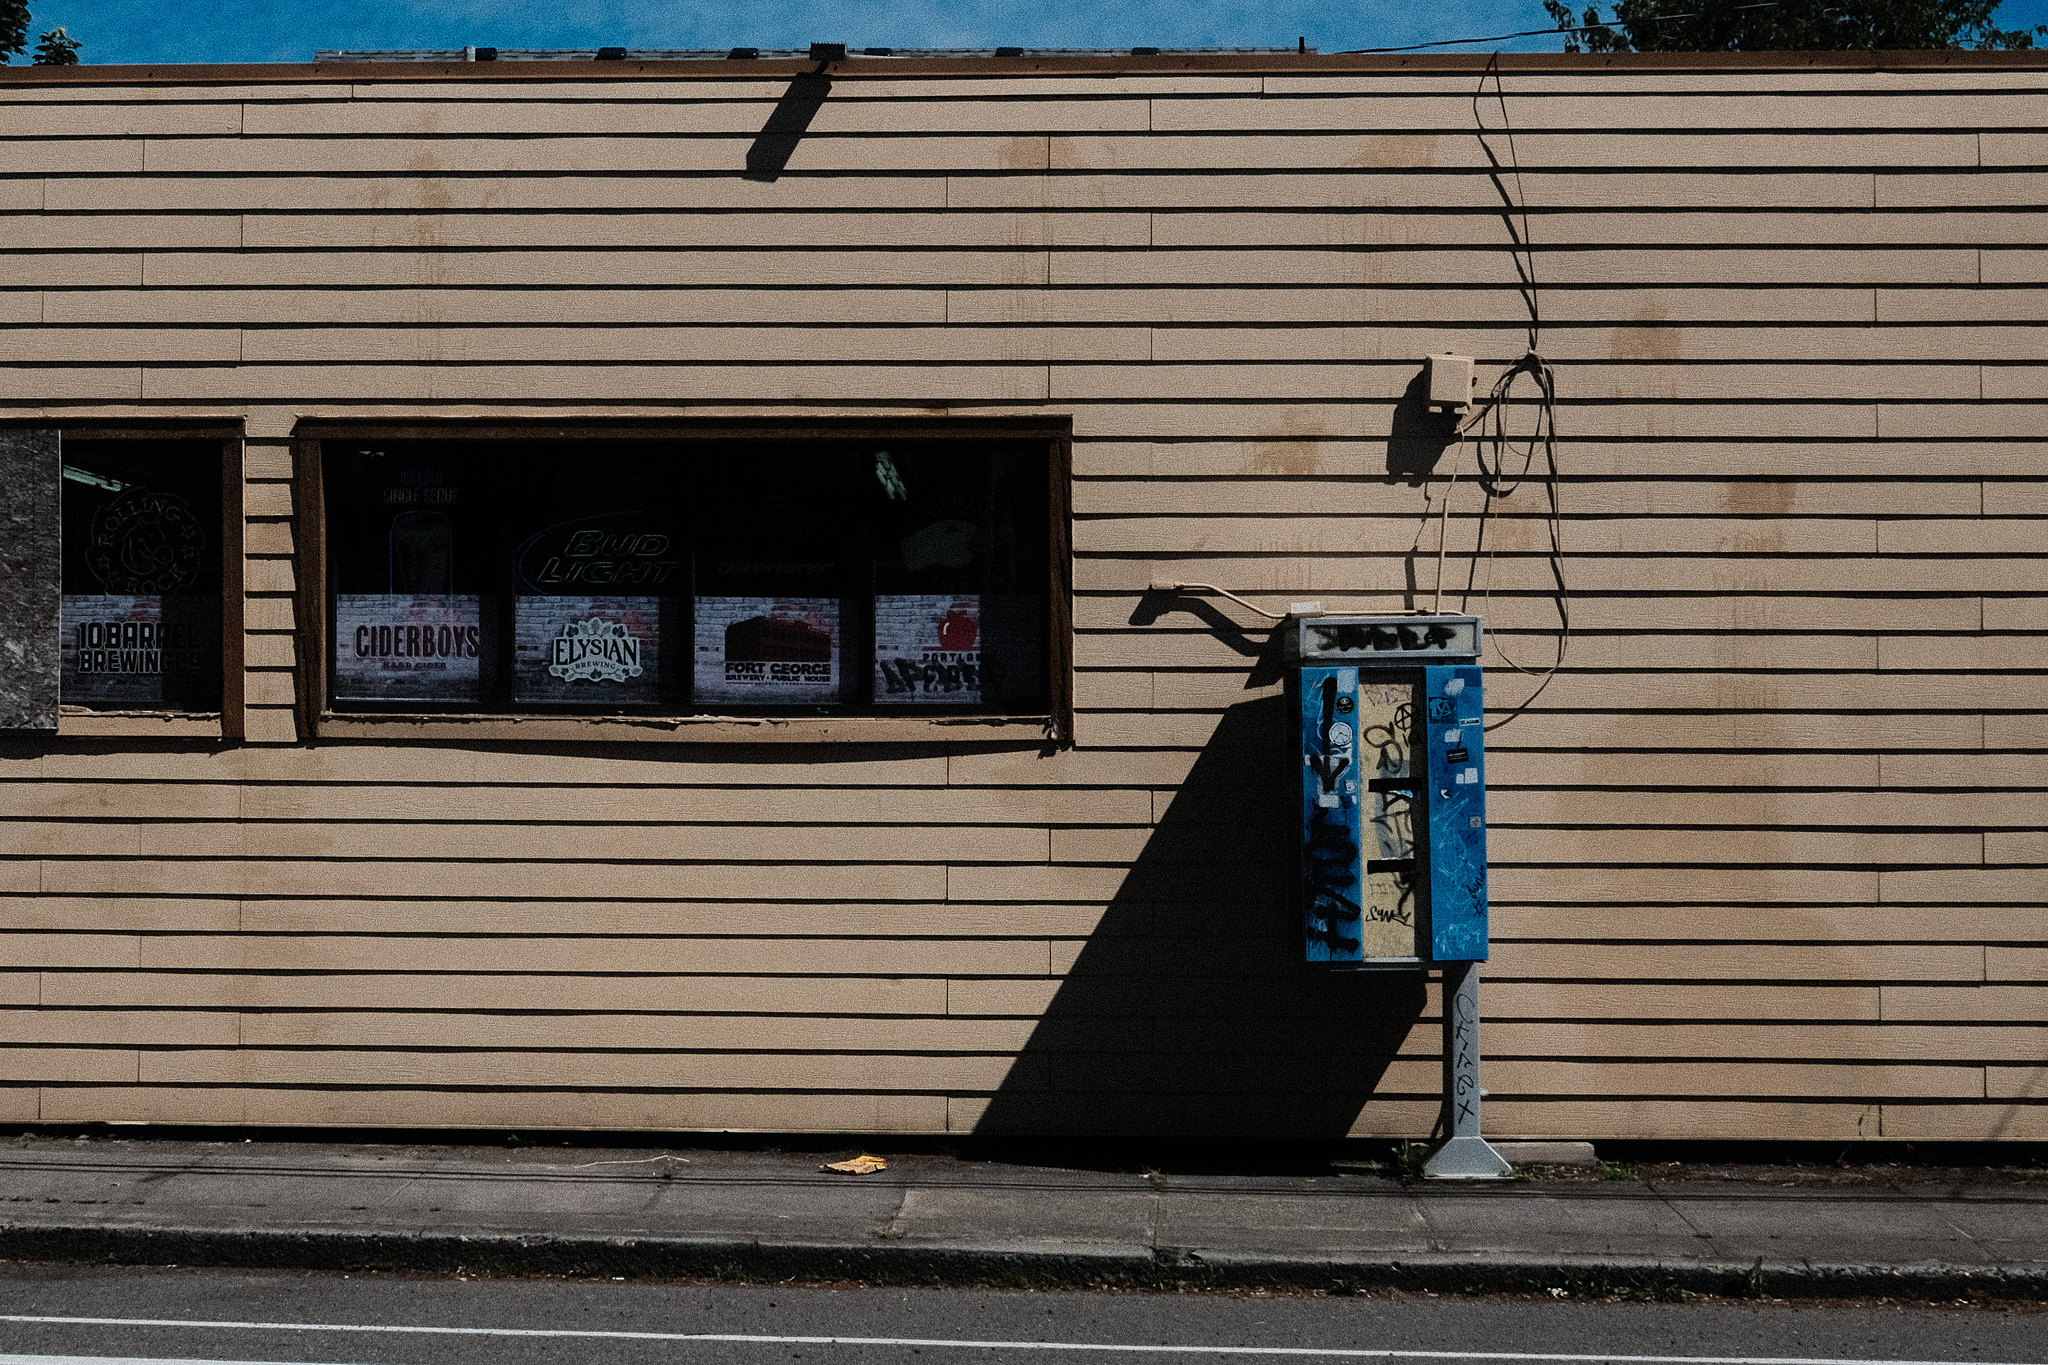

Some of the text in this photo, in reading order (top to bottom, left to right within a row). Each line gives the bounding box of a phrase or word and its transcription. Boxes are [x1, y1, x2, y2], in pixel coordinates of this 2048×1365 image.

[355, 625, 480, 658] CIDERBOYS
[555, 638, 637, 666] ELYSIAN
[79, 650, 171, 673] BREWING
[574, 660, 616, 670] BREWING
[725, 662, 831, 675] FORT GEORGE
[725, 674, 831, 683] BREWERY PUBLIC HOUSE
